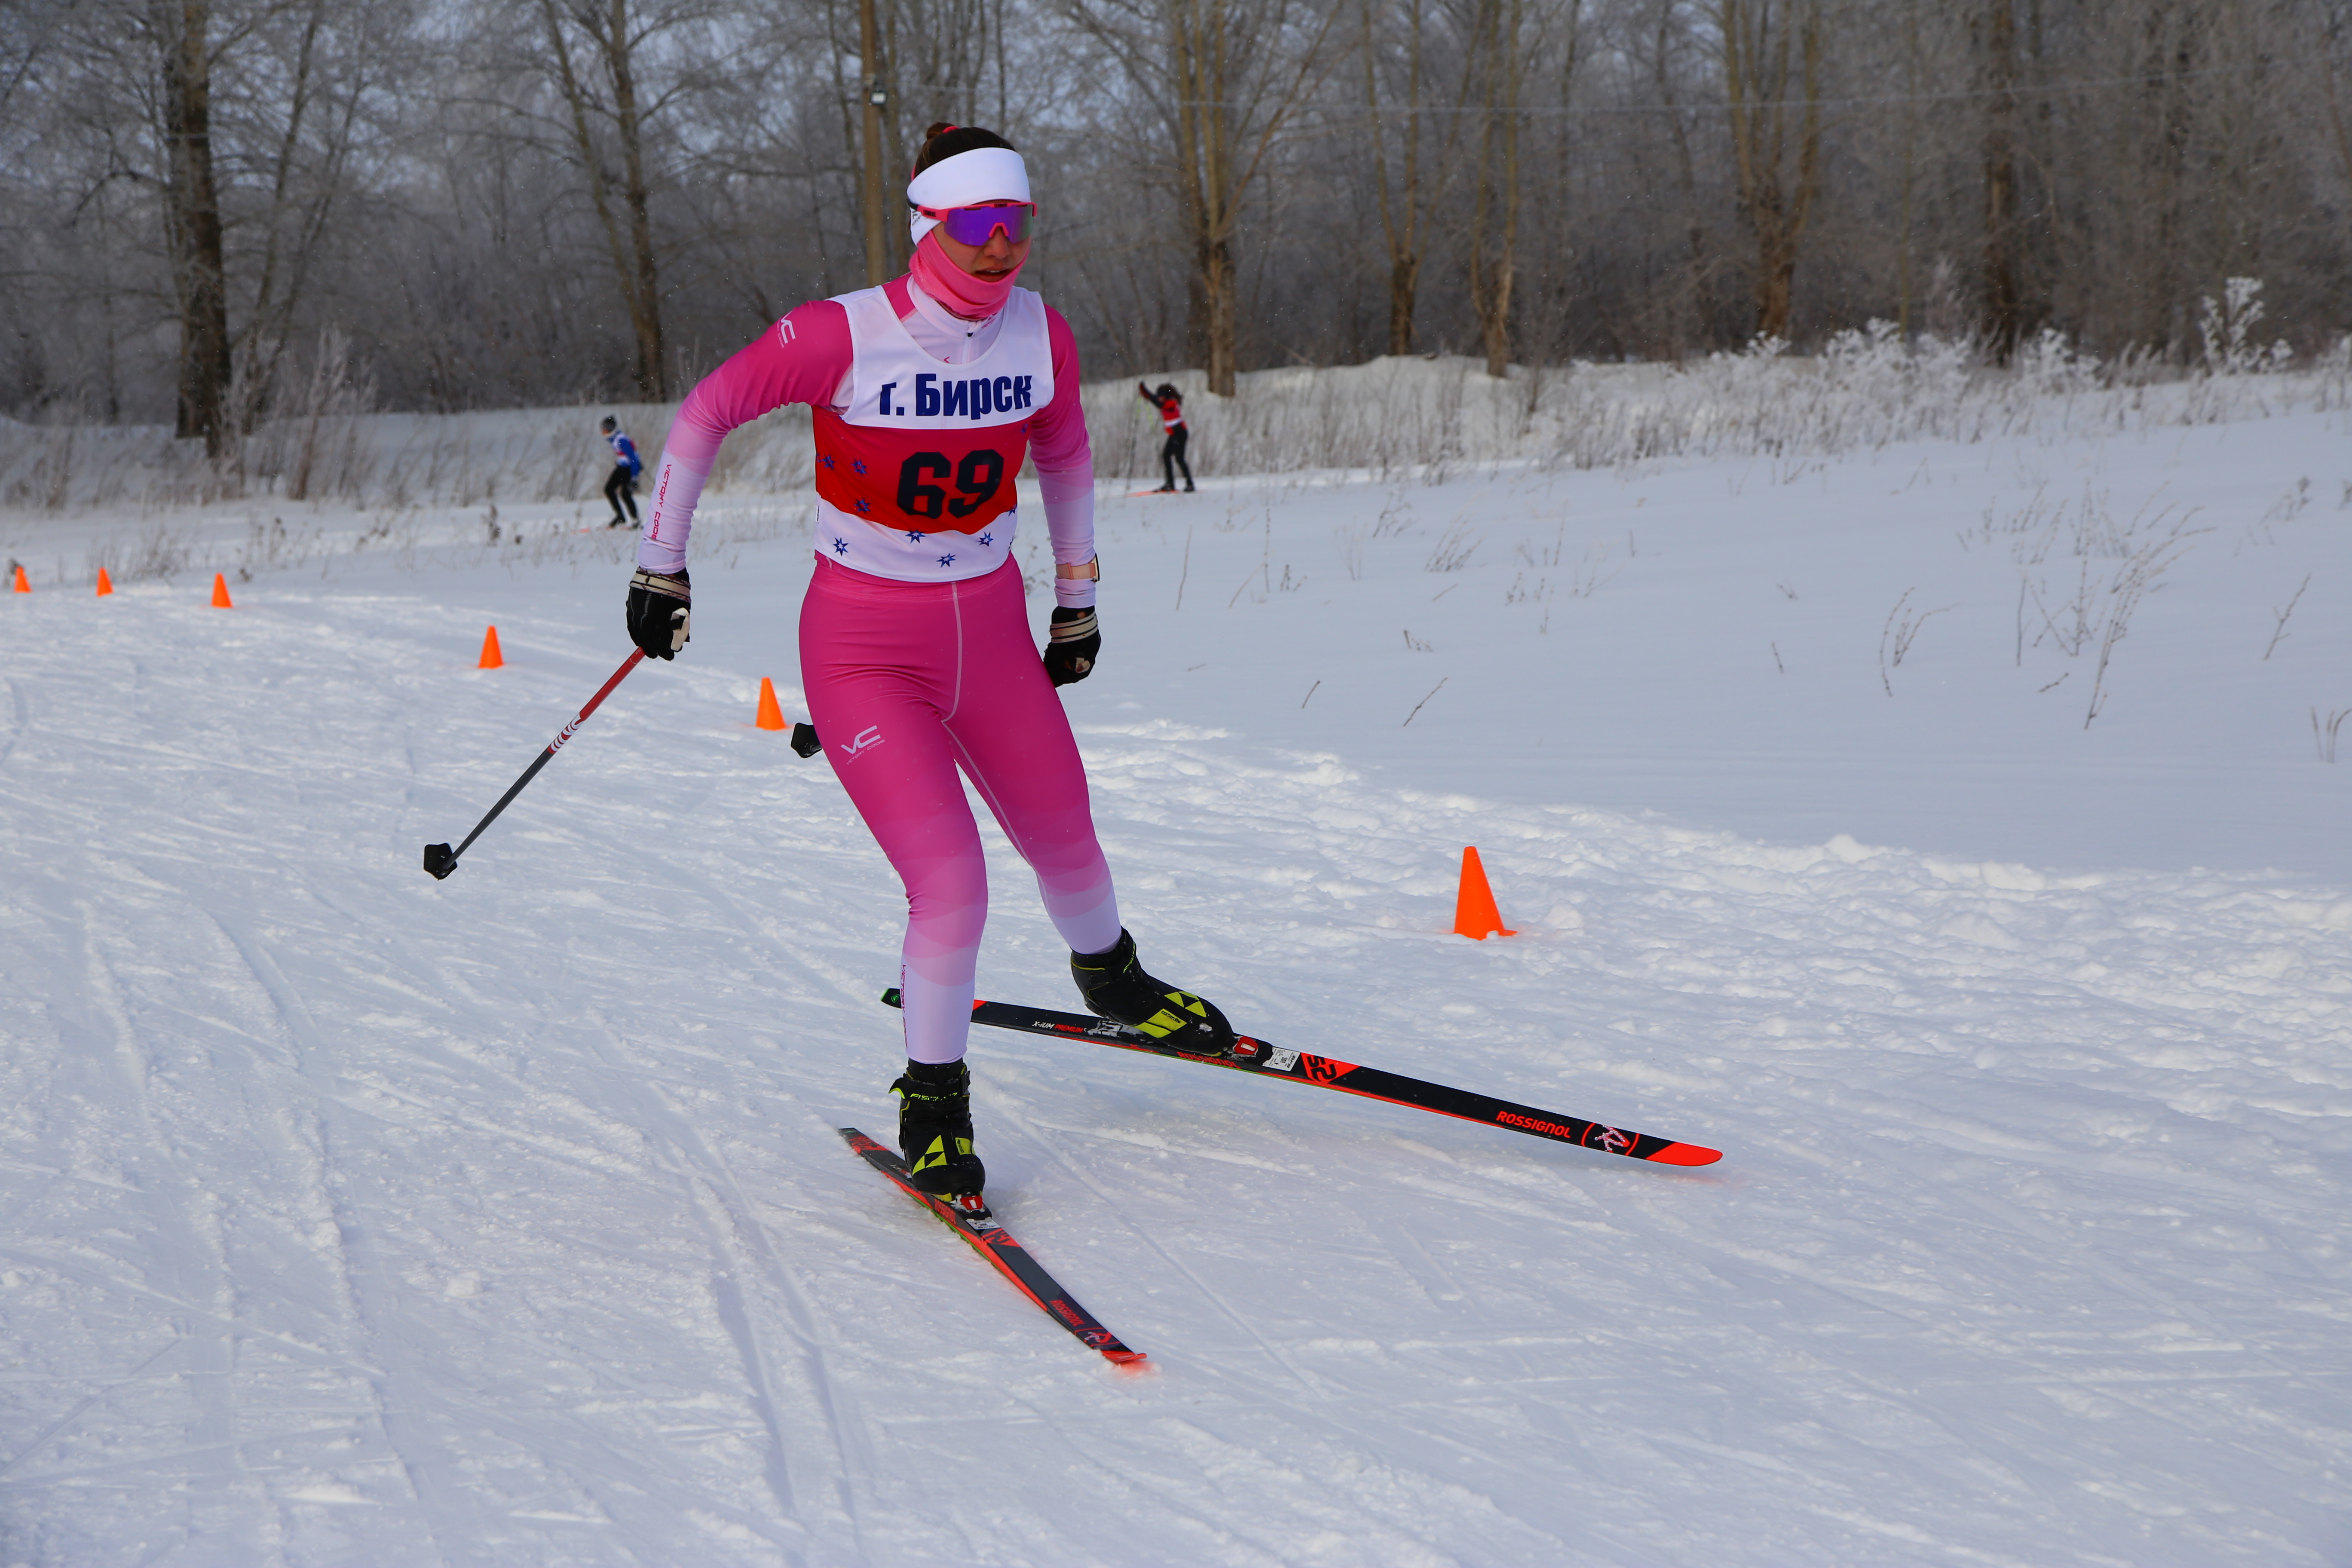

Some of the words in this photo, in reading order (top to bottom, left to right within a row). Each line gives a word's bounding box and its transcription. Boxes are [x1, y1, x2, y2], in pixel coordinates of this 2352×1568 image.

[880, 382, 904, 416] г.
[916, 373, 1032, 420] Бирск
[659, 464, 672, 508] VICTORY
[897, 449, 1004, 519] 69
[651, 511, 661, 539] CODE
[846, 750, 865, 765] VICTORY
[867, 739, 885, 750] CODE
[1054, 1024, 1084, 1033] PREMIUM
[1161, 1011, 1175, 1021] carbon
[1176, 1051, 1242, 1069] ROSSIGNOL
[1496, 1111, 1571, 1139] ROSSIGNOL
[1048, 1299, 1086, 1326] ROSSIGNOL
